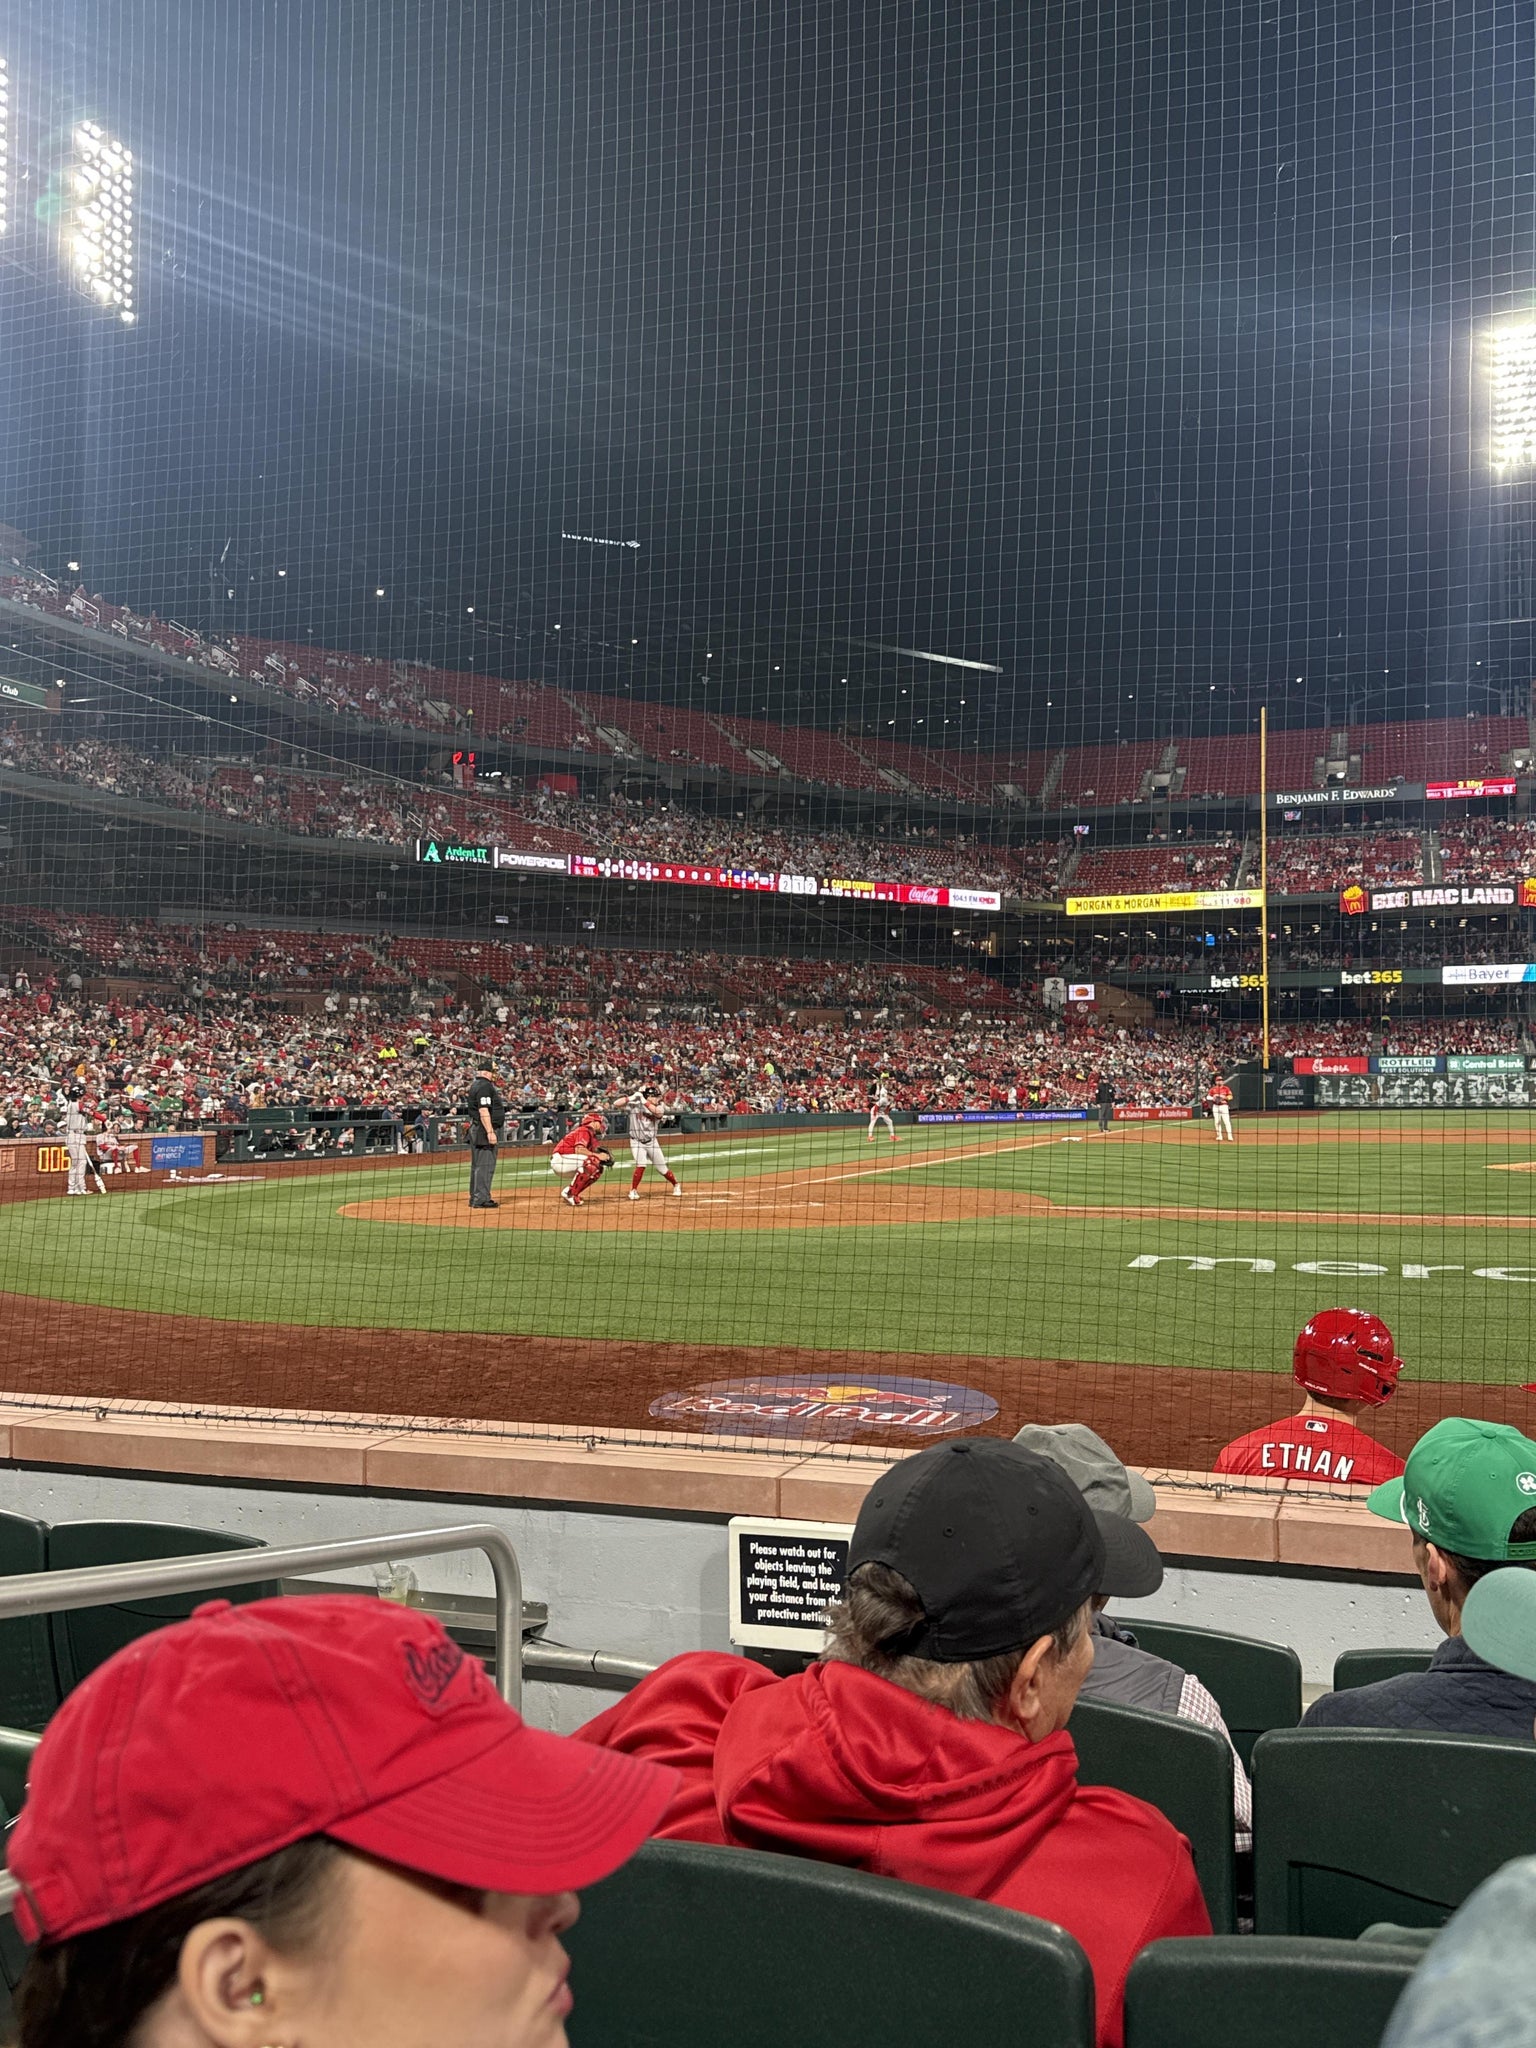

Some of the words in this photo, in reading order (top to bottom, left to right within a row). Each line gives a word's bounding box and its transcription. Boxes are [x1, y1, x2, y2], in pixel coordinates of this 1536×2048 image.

[2, 684, 19, 697] Club
[1276, 793, 1329, 805] BENJAMIN
[1331, 790, 1340, 801] F.
[1343, 788, 1395, 800] EDWARDS
[445, 845, 475, 858] Ardent
[476, 848, 488, 859] IT
[445, 855, 487, 864] SOLUTIONS
[1076, 900, 1112, 912] MORGAN
[1123, 897, 1161, 909] MORGAN
[1372, 891, 1410, 910] BIG
[1412, 889, 1460, 906] MAC
[1461, 887, 1514, 905] LAND
[1341, 970, 1402, 985] bet365
[1468, 968, 1510, 980] Bayer
[1380, 1058, 1433, 1067] ROTTLER
[1463, 1059, 1496, 1069] Central
[1498, 1058, 1524, 1068] Bank
[38, 1146, 72, 1173] 006
[1261, 1443, 1355, 1482] ETHAN
[749, 1542, 777, 1556] Please
[779, 1545, 805, 1558] watch
[807, 1549, 821, 1559] out
[823, 1547, 837, 1560] for
[754, 1558, 784, 1574] objects
[785, 1560, 816, 1577] leaving
[818, 1562, 832, 1575] the
[746, 1573, 777, 1590] playing
[779, 1575, 800, 1590] field,
[802, 1578, 818, 1590] and
[820, 1578, 841, 1595] keep
[748, 1592, 768, 1605] your
[769, 1590, 804, 1605] distance
[805, 1593, 826, 1606] from
[828, 1595, 842, 1607] the
[757, 1608, 800, 1621] protective
